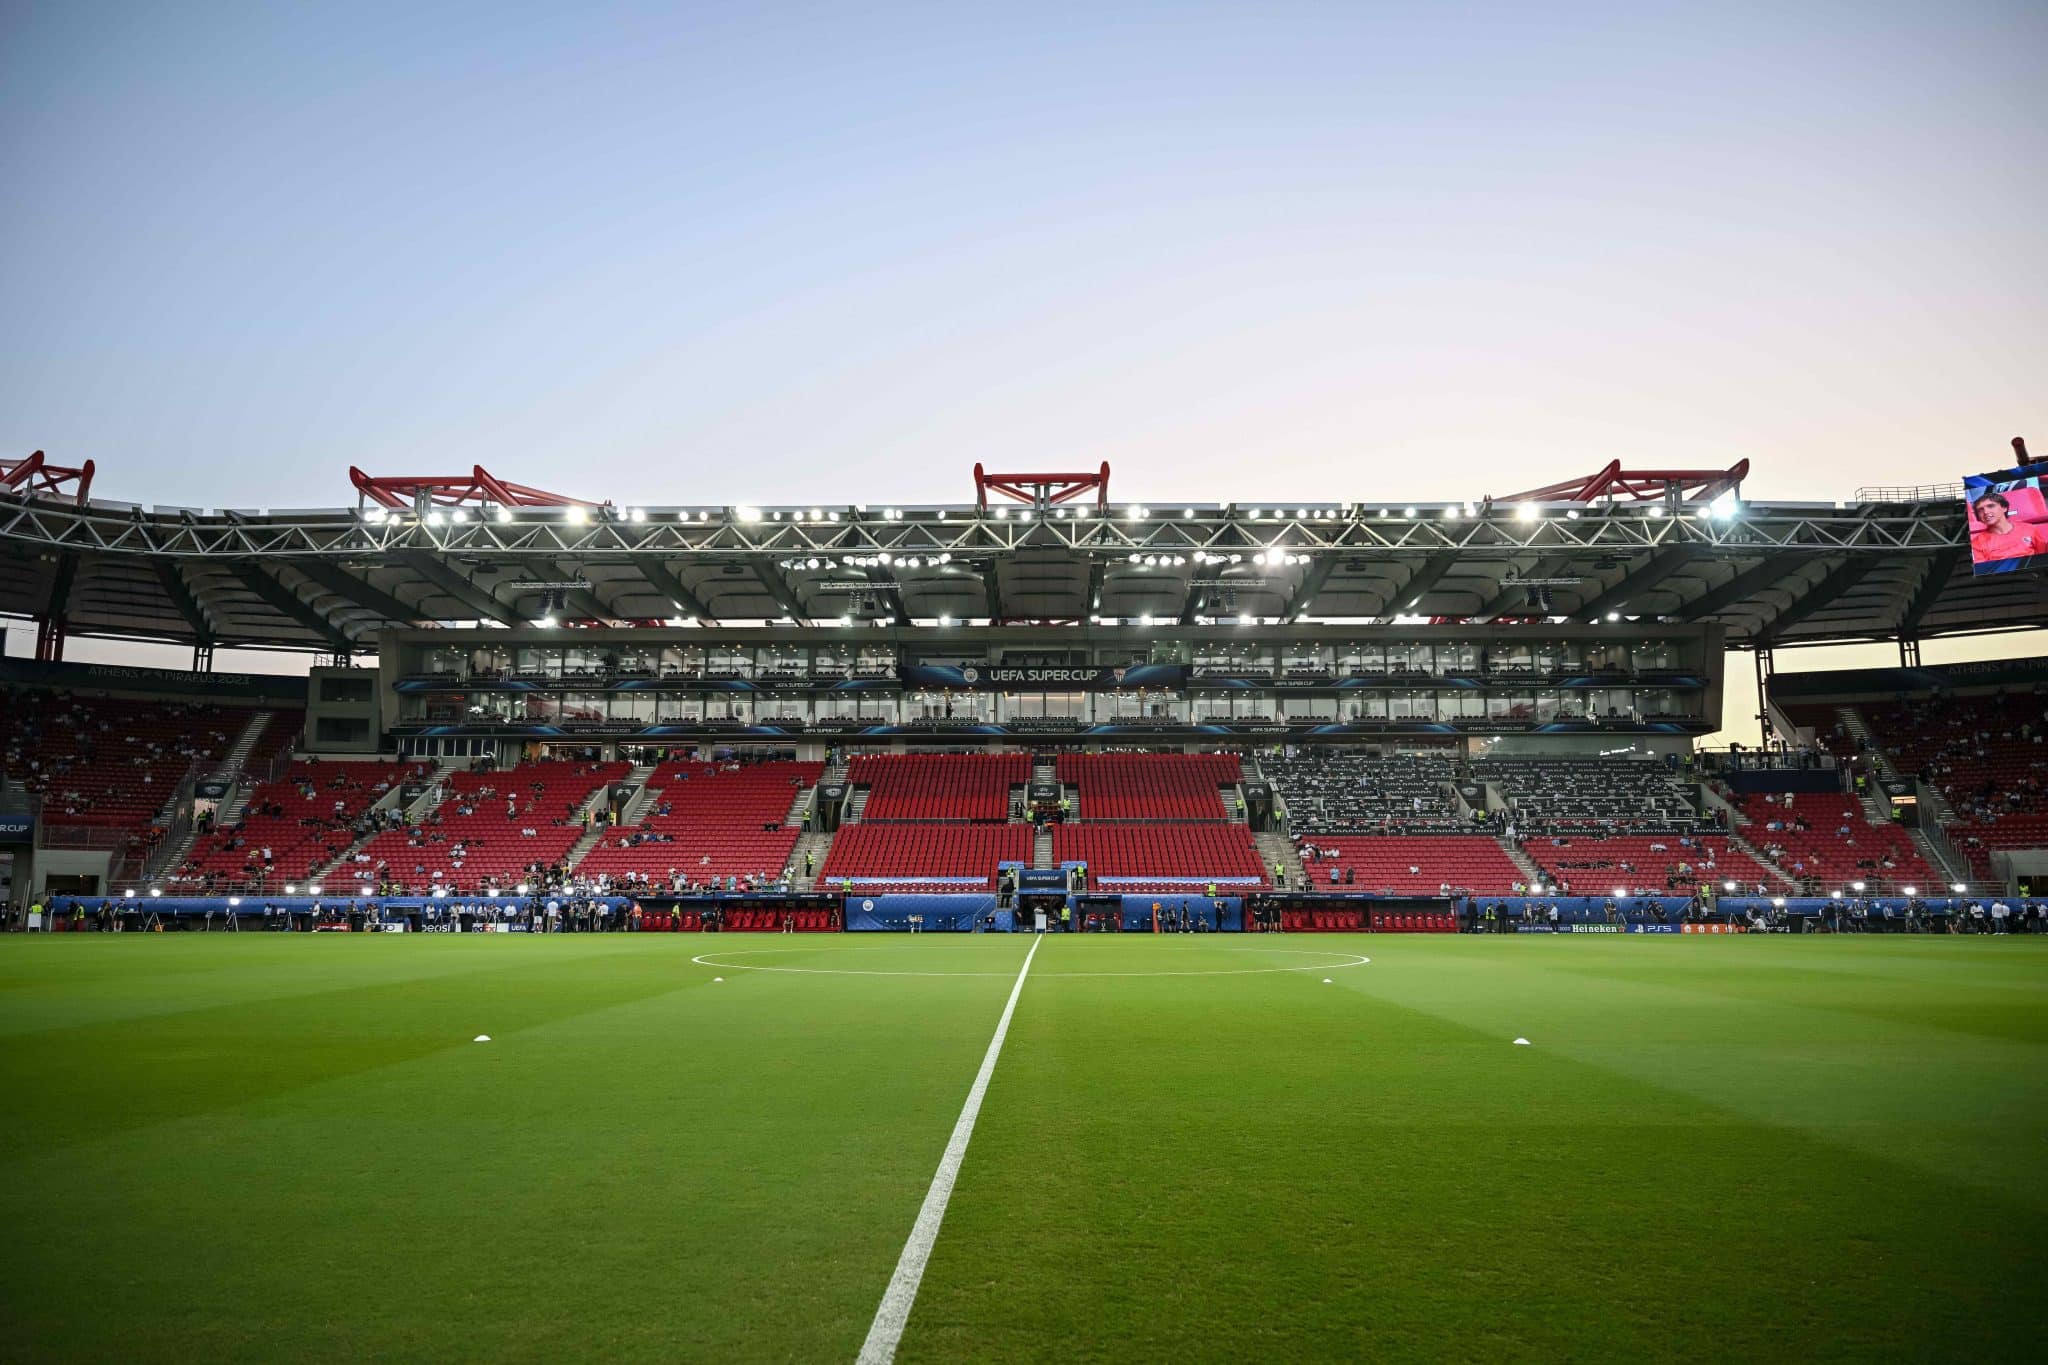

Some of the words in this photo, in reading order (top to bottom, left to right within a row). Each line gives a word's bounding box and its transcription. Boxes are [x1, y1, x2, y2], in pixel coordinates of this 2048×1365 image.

[88, 666, 138, 679] ATHENS
[165, 670, 216, 684] PIRAEUS
[990, 669, 1025, 681] UEFA
[1572, 923, 1617, 933] Heineken
